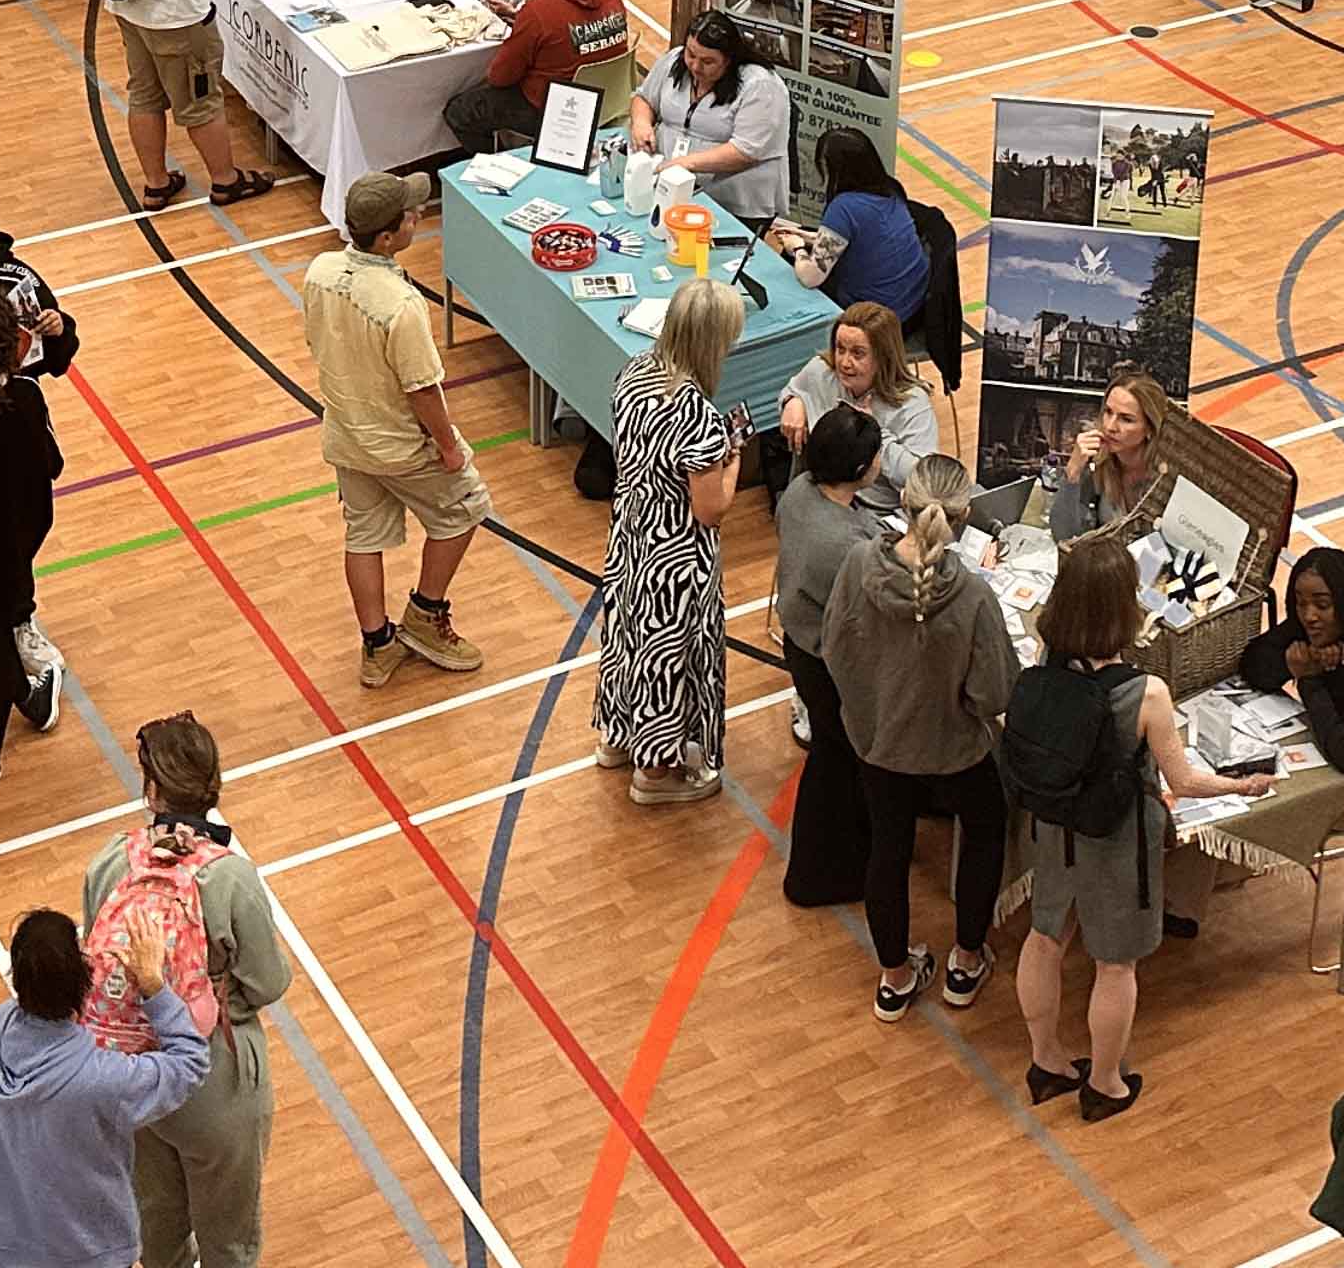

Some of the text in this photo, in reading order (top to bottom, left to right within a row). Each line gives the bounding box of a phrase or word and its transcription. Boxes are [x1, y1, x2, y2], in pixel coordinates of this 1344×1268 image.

[232, 1, 309, 98] CORBENIC
[784, 77, 813, 93] FFER
[814, 86, 824, 97] A
[828, 91, 857, 109] 100%
[812, 98, 882, 127] GUARANTEE
